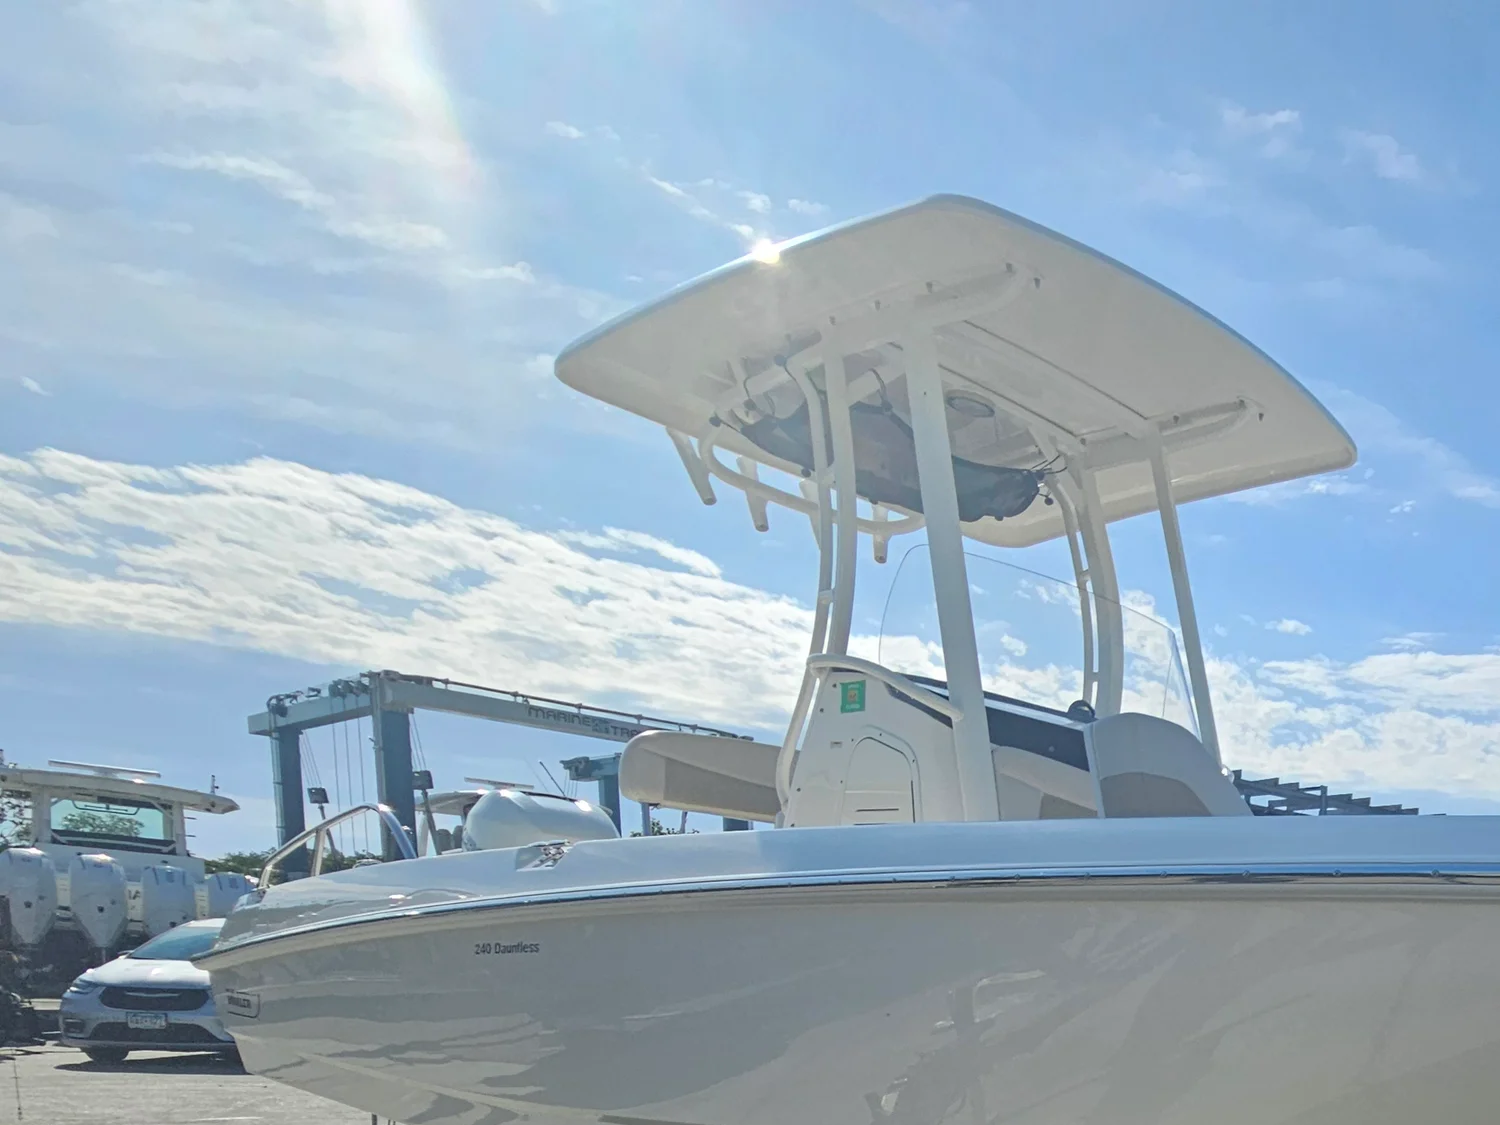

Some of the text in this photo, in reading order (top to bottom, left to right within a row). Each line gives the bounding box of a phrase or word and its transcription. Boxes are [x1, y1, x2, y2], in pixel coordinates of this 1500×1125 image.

[610, 725, 642, 738] TRA
[474, 941, 540, 955] 240 Dauntless
